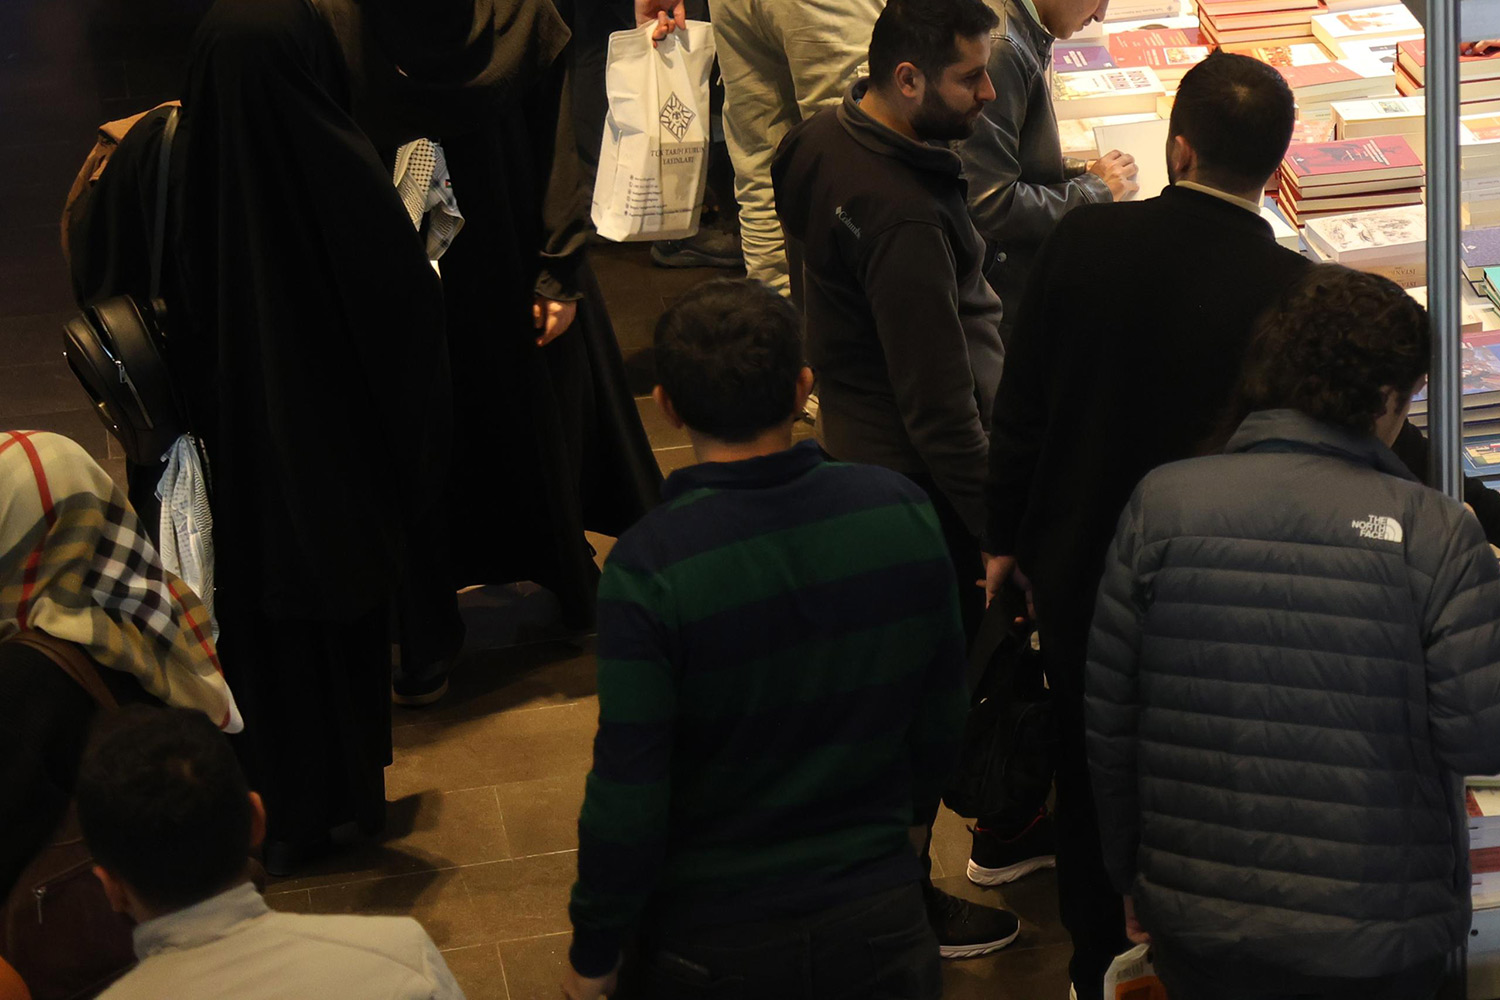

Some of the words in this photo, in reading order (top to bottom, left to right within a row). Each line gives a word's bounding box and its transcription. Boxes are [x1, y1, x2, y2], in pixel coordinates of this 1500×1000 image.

[838, 210, 861, 240] Columb
[1351, 519, 1387, 534] NORTH
[1367, 513, 1388, 526] THE
[1360, 529, 1385, 541] FACE
